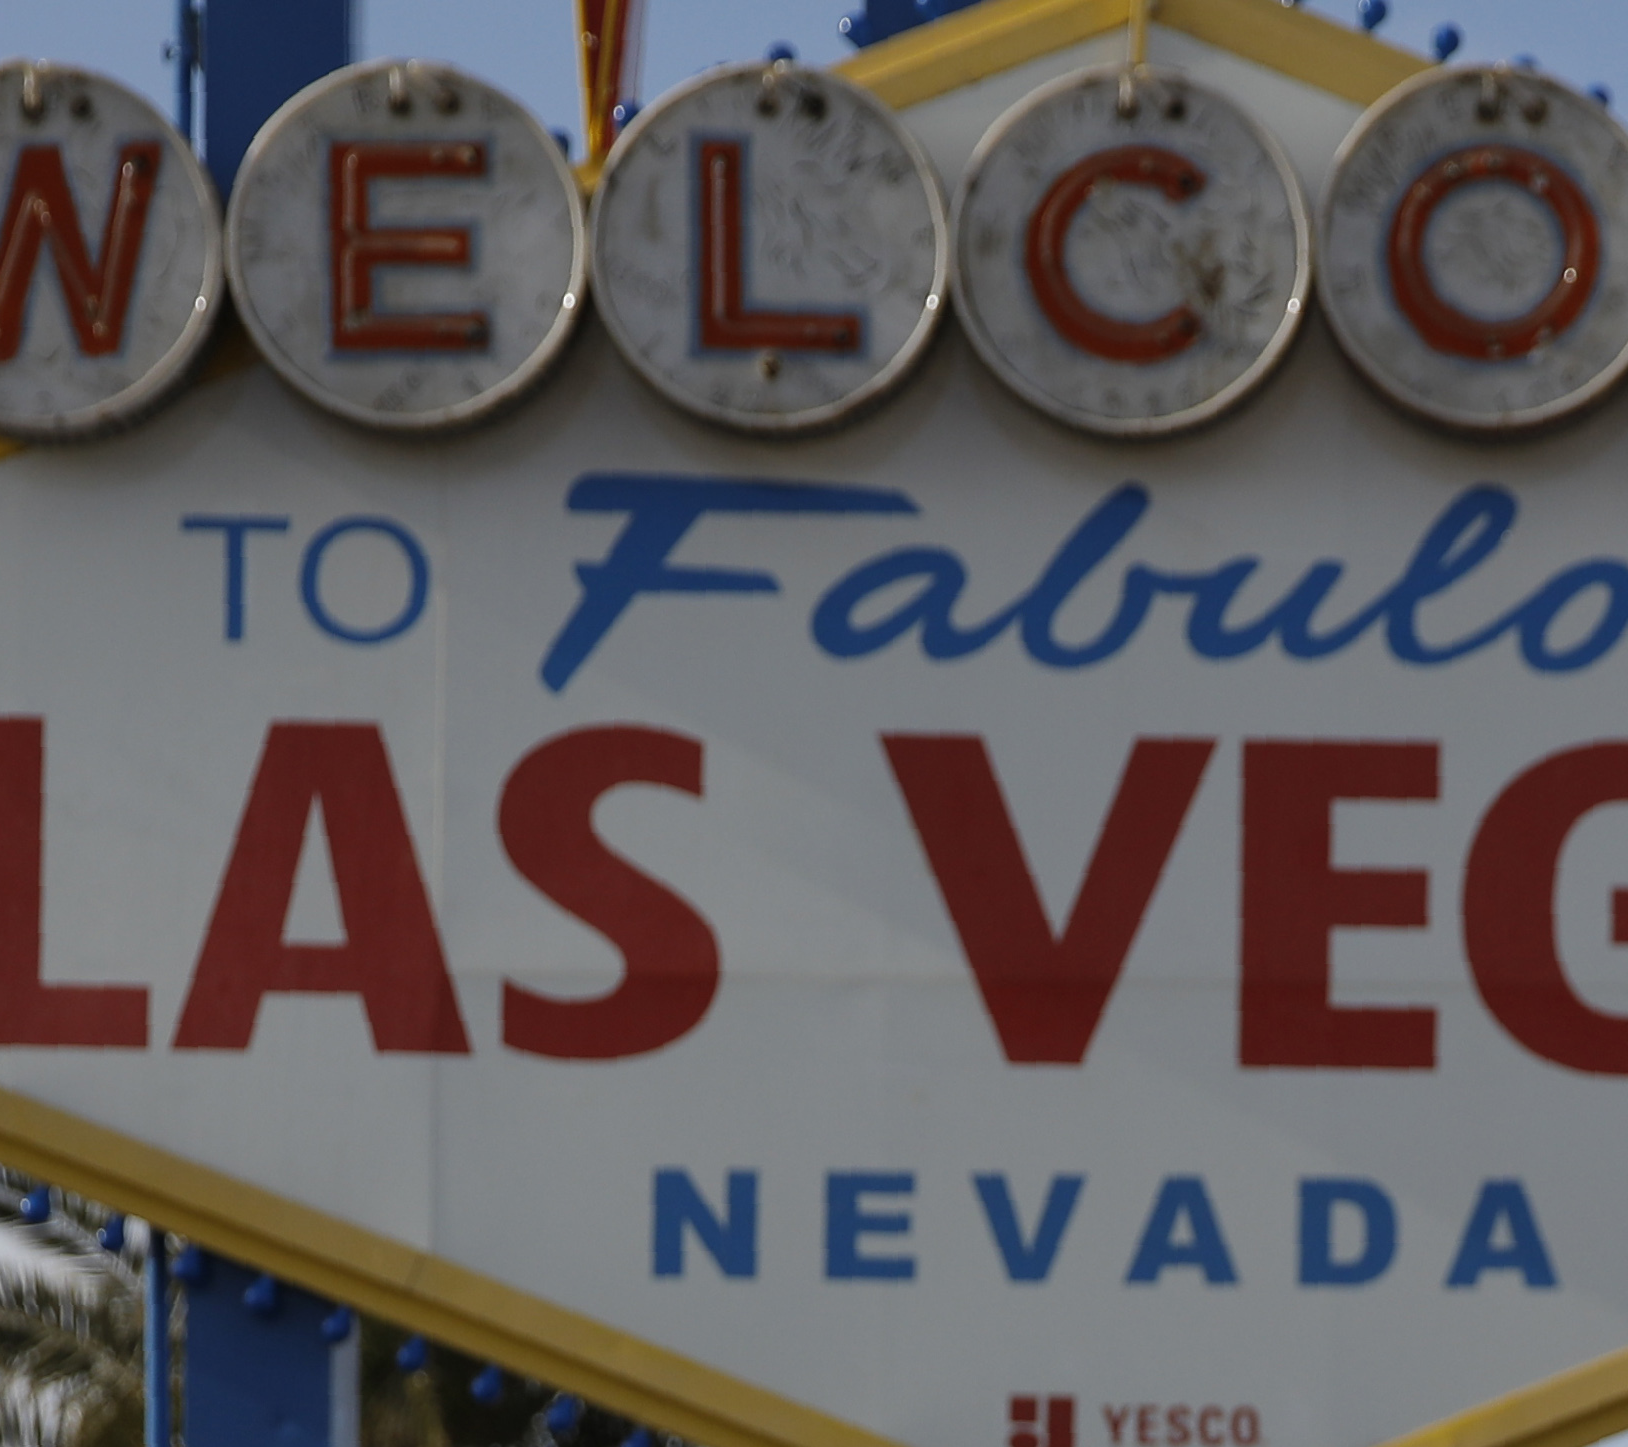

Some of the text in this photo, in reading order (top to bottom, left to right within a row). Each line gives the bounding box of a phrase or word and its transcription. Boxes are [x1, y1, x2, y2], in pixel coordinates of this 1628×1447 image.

[181, 514, 432, 646] TO
[650, 1167, 1561, 1290] NEVADA
[1103, 1404, 1260, 1447] YESCO
